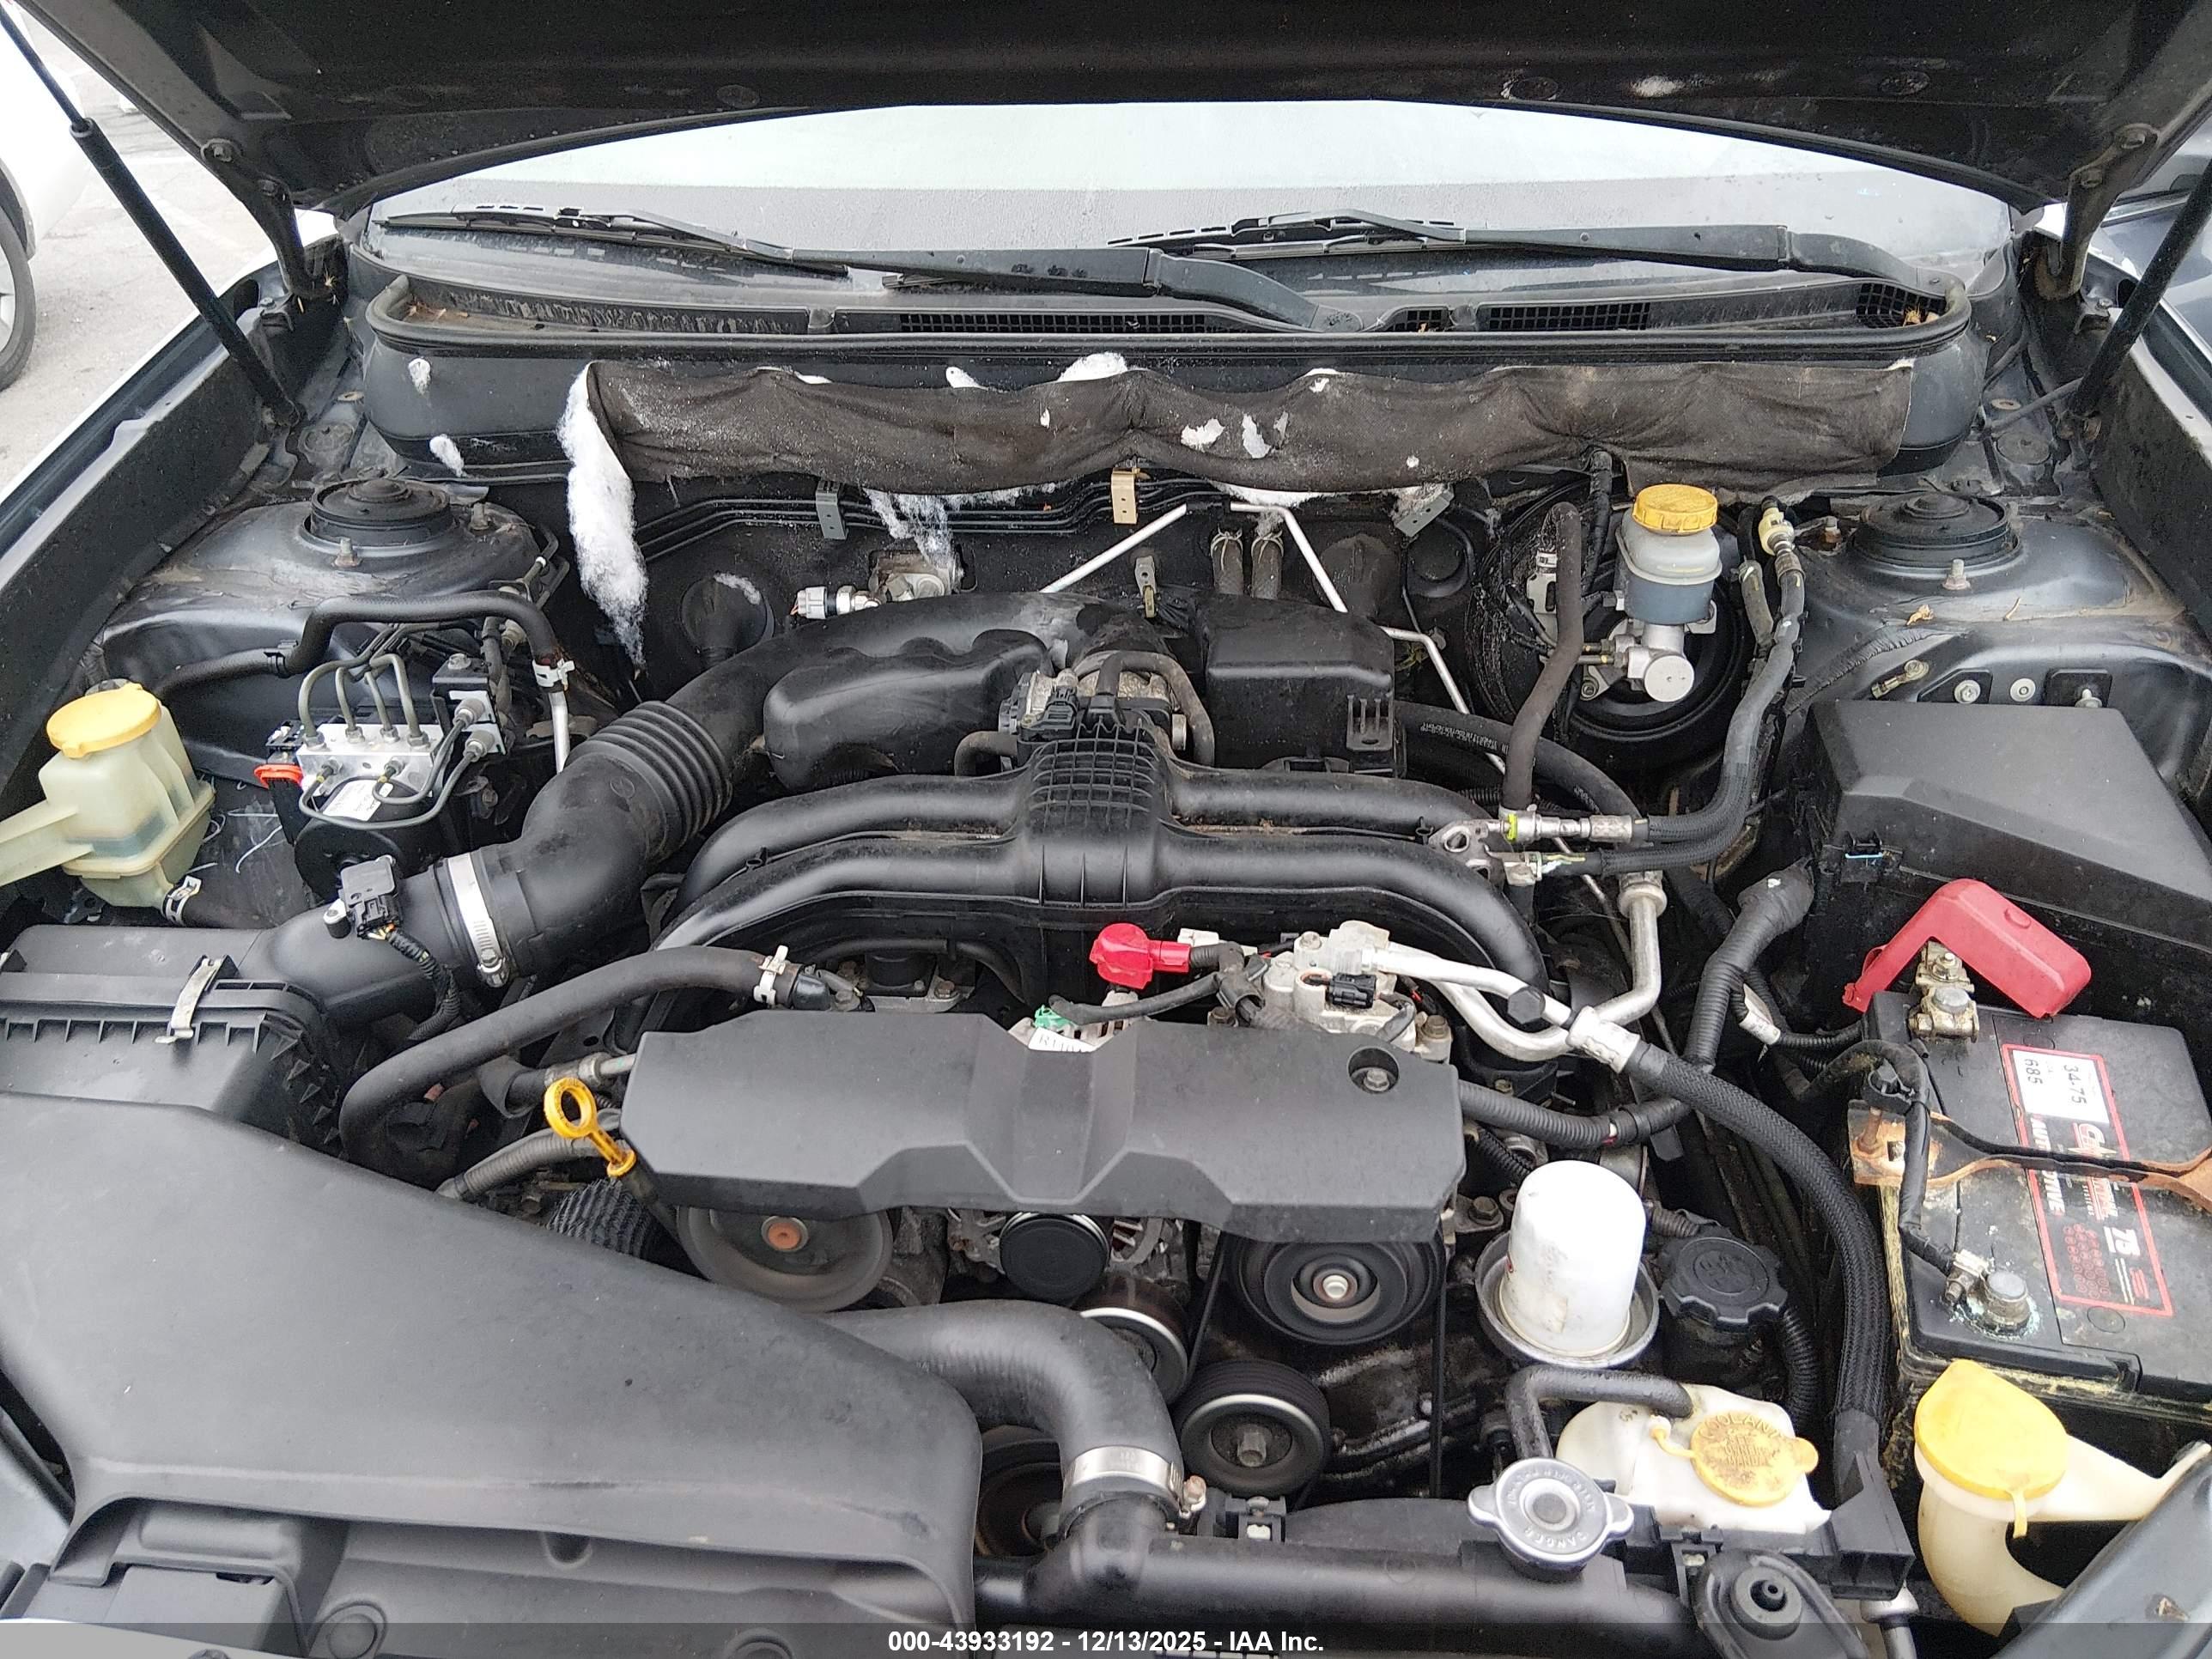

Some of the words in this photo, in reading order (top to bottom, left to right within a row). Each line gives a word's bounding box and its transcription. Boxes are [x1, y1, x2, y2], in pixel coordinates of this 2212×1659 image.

[2024, 1058, 2044, 1085] 685
[2111, 1227, 2141, 1256] 75
[1698, 1413, 1782, 1439] COOLANT
[1523, 1526, 1589, 1549] DANGER
